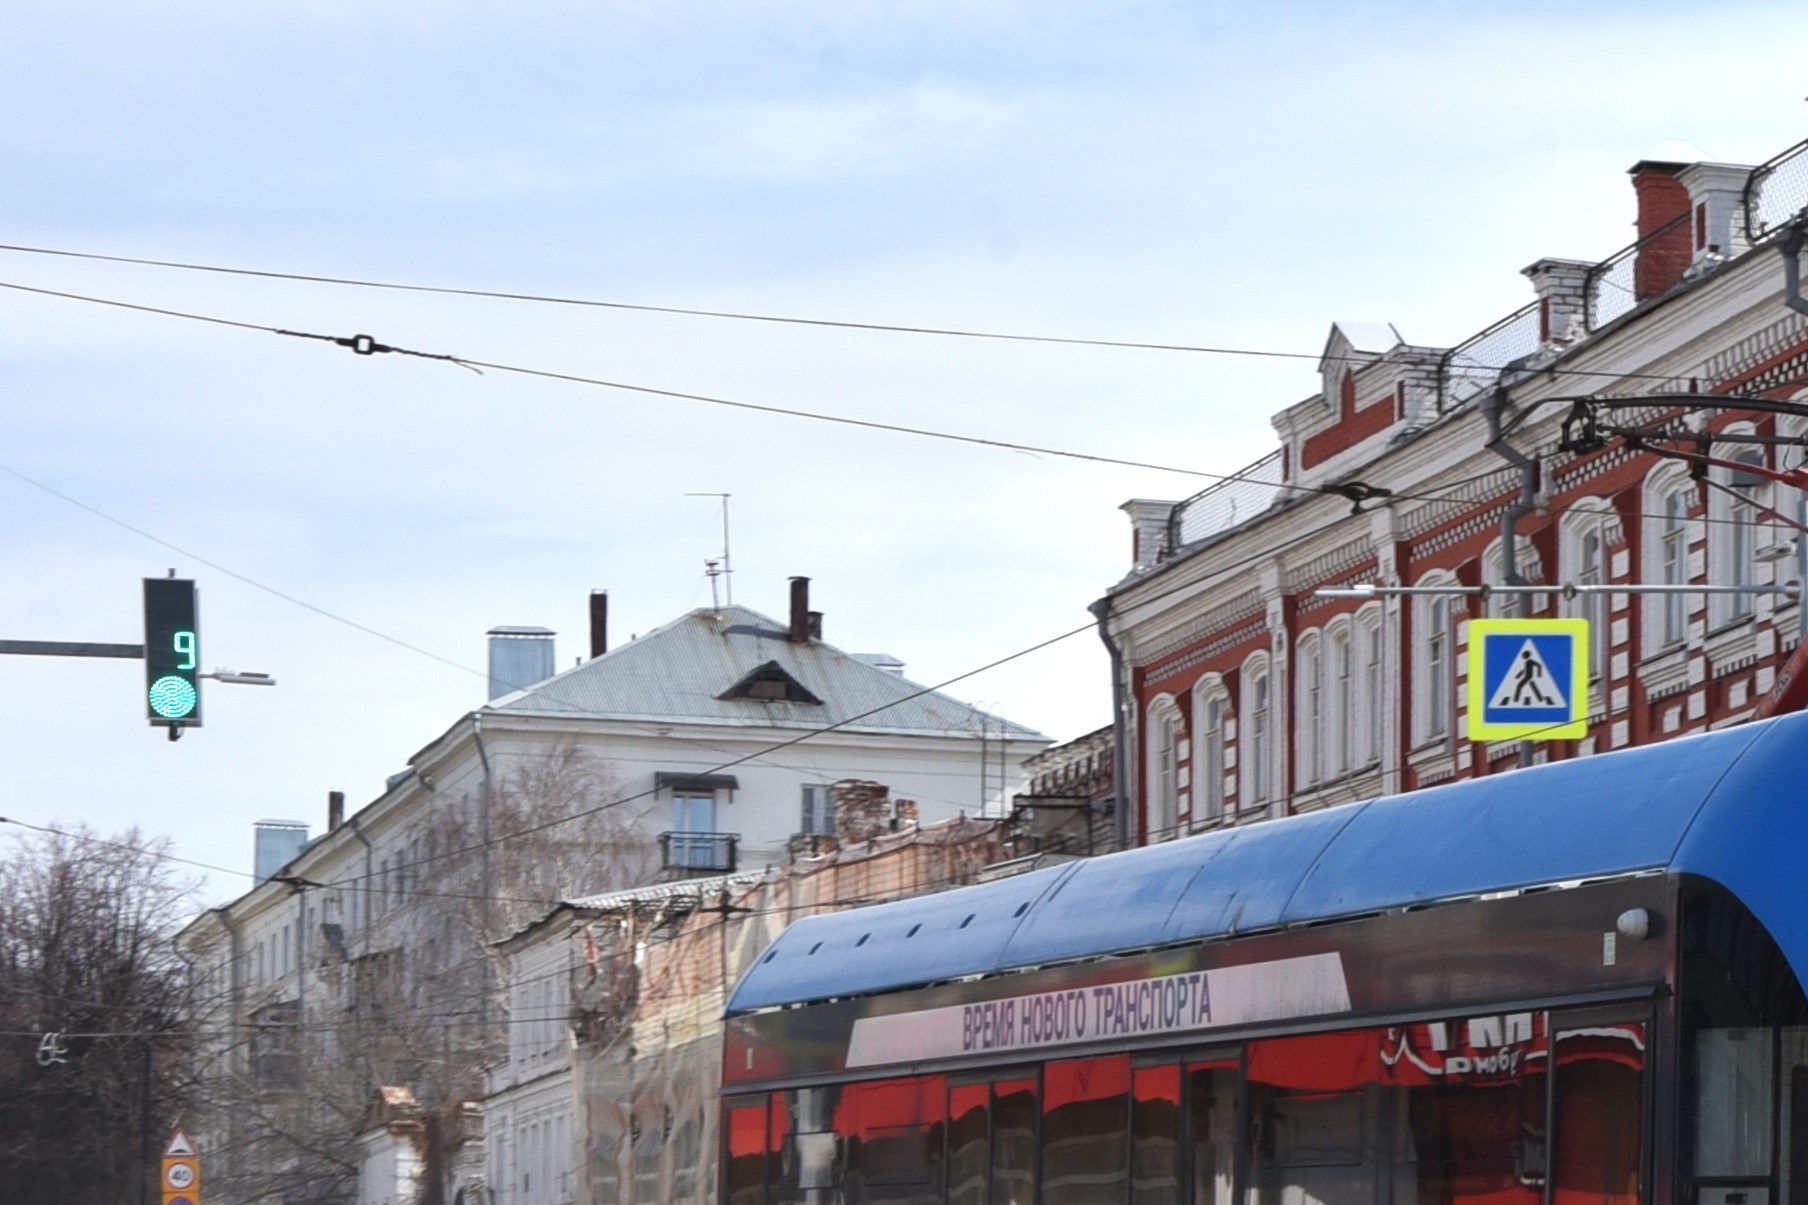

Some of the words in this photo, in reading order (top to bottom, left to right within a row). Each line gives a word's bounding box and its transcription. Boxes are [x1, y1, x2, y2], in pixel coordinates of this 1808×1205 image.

[173, 631, 196, 669] 9
[963, 1001, 1015, 1050] ВРЕМЯ
[1021, 991, 1086, 1044] НОВОГО
[1094, 974, 1212, 1035] ТРАНСПОРТА
[171, 1170, 190, 1182] 40
